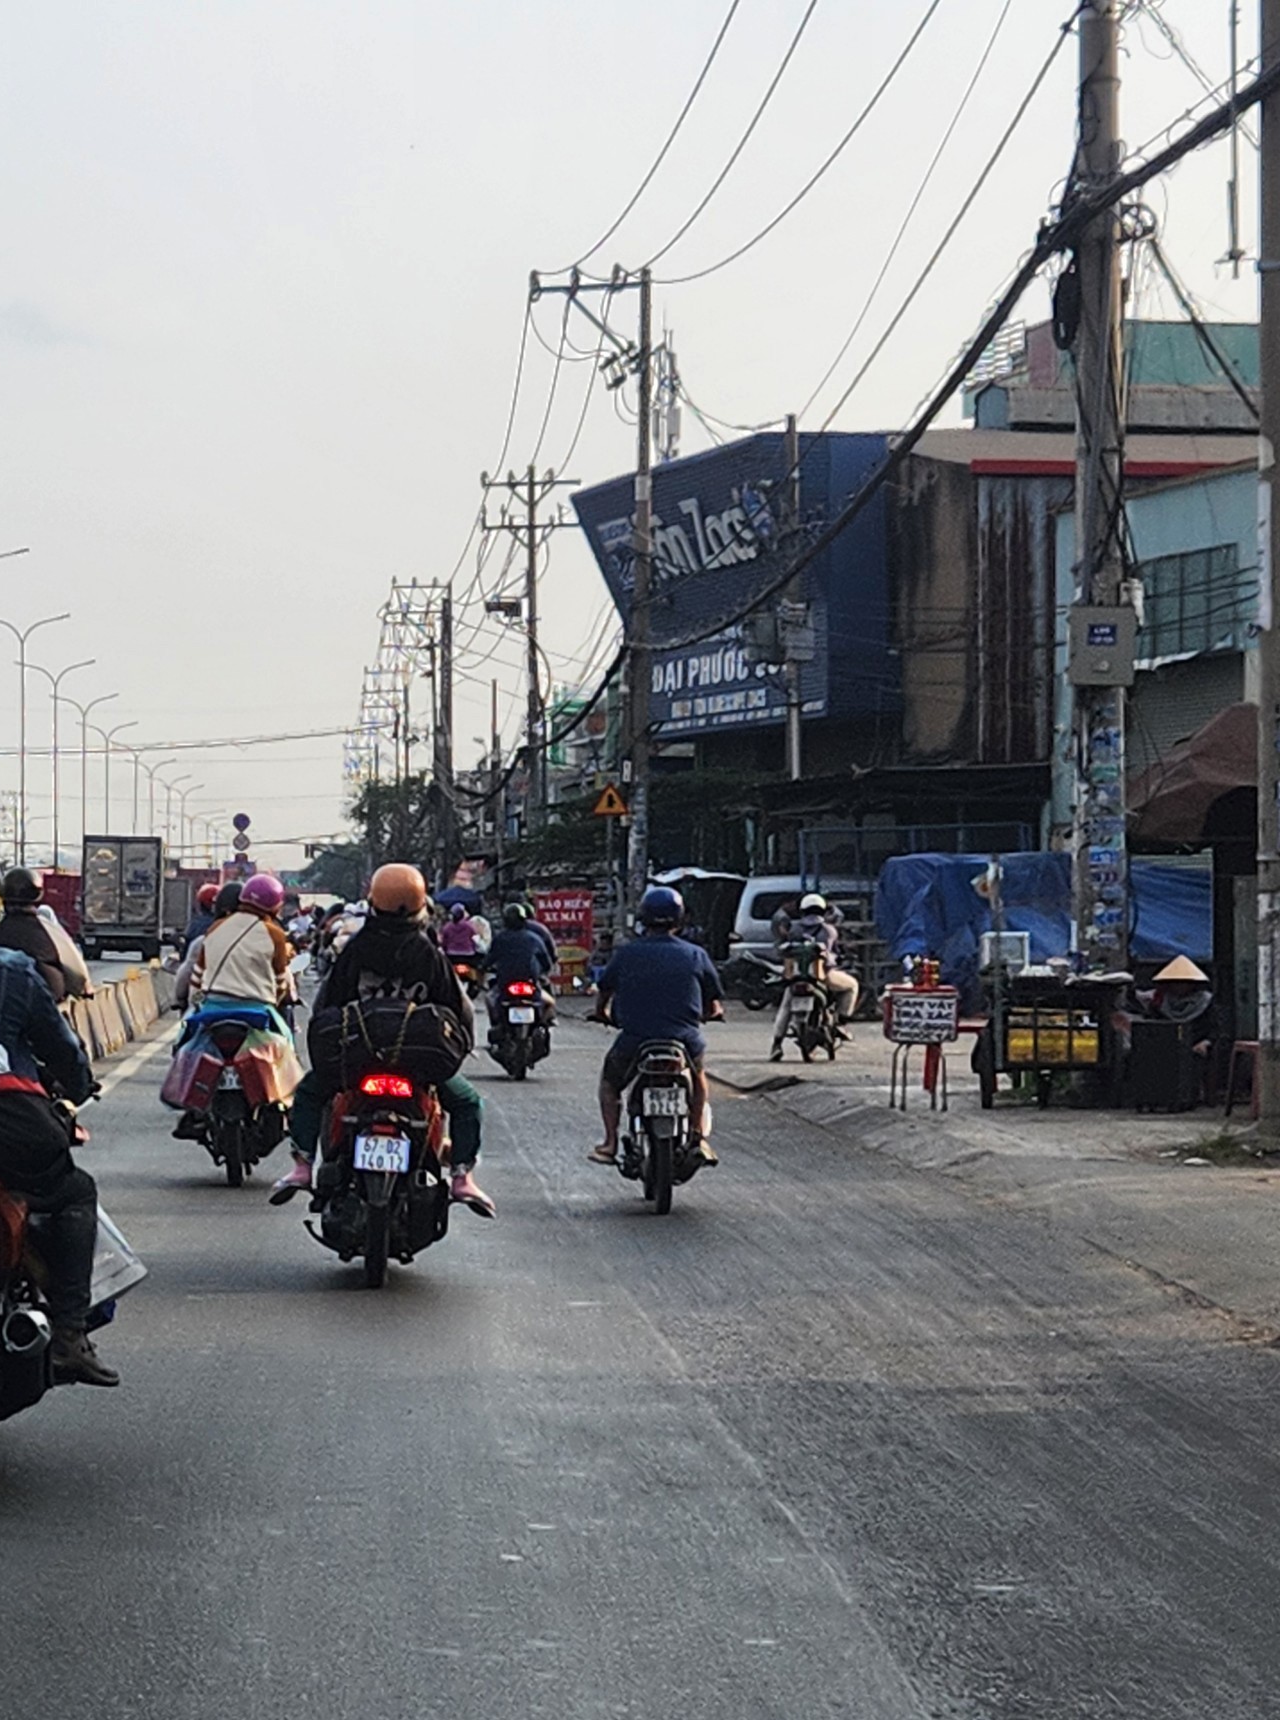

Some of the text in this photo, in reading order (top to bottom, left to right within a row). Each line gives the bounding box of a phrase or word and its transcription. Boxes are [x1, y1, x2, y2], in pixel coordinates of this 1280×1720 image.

[652, 660, 683, 698] ĐẠI
[544, 911, 558, 922] XE
[364, 1138, 401, 1154] 67-D2
